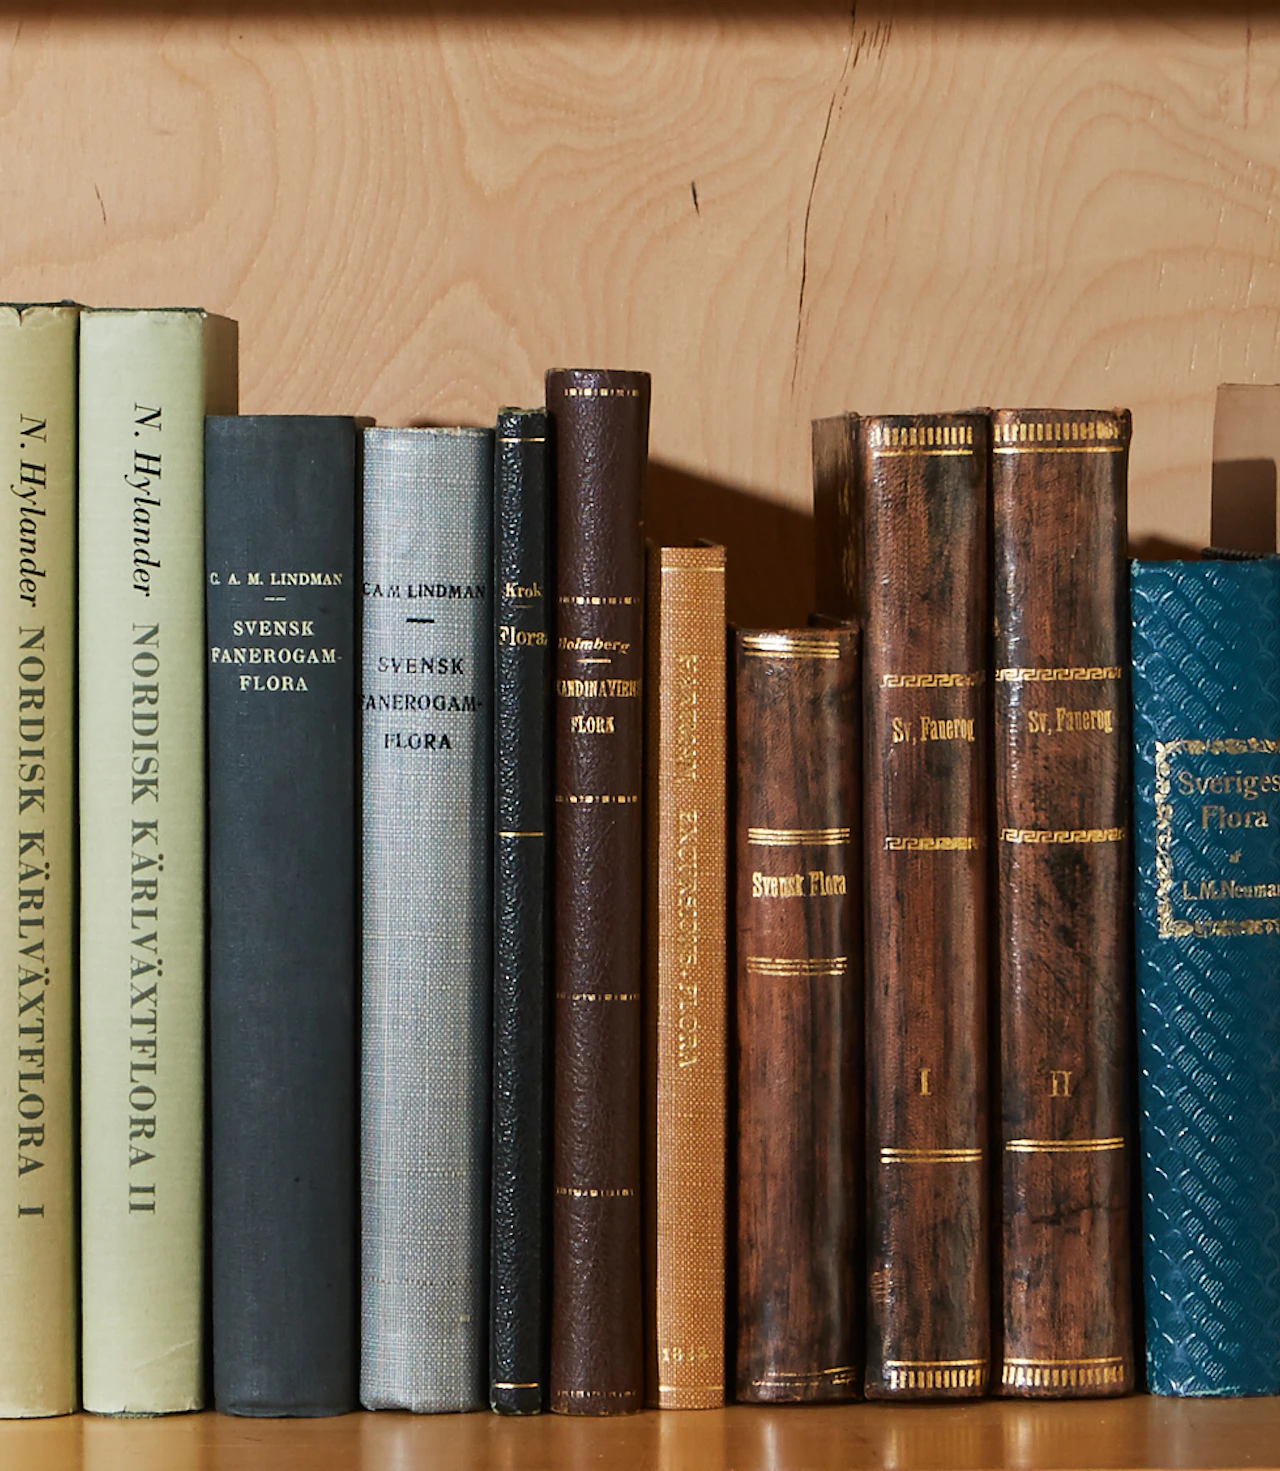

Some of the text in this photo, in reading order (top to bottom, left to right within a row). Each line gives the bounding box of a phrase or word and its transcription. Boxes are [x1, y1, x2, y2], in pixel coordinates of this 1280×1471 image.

[247, 572, 264, 586] M.
[270, 572, 343, 586] LINDMAN
[408, 583, 486, 600] LINDMAN
[505, 582, 543, 599] Krok
[233, 620, 315, 637] SVENSK
[211, 647, 342, 664] FANEROGAM-
[377, 657, 464, 675] SVENSK
[239, 675, 309, 692] FLORA
[569, 714, 616, 734] FLORA
[384, 733, 452, 750] FLORA
[10, 413, 50, 1219] N. Hylander NORDISK KÄRLVÄXTFLORA I
[124, 402, 164, 1215] N. Hylander NORDISK KÄRLVÄXTFLORA II
[1201, 804, 1269, 829] Flora
[752, 870, 847, 898] Svensk Flora
[920, 1067, 932, 1097] I
[1050, 1070, 1072, 1098] II
